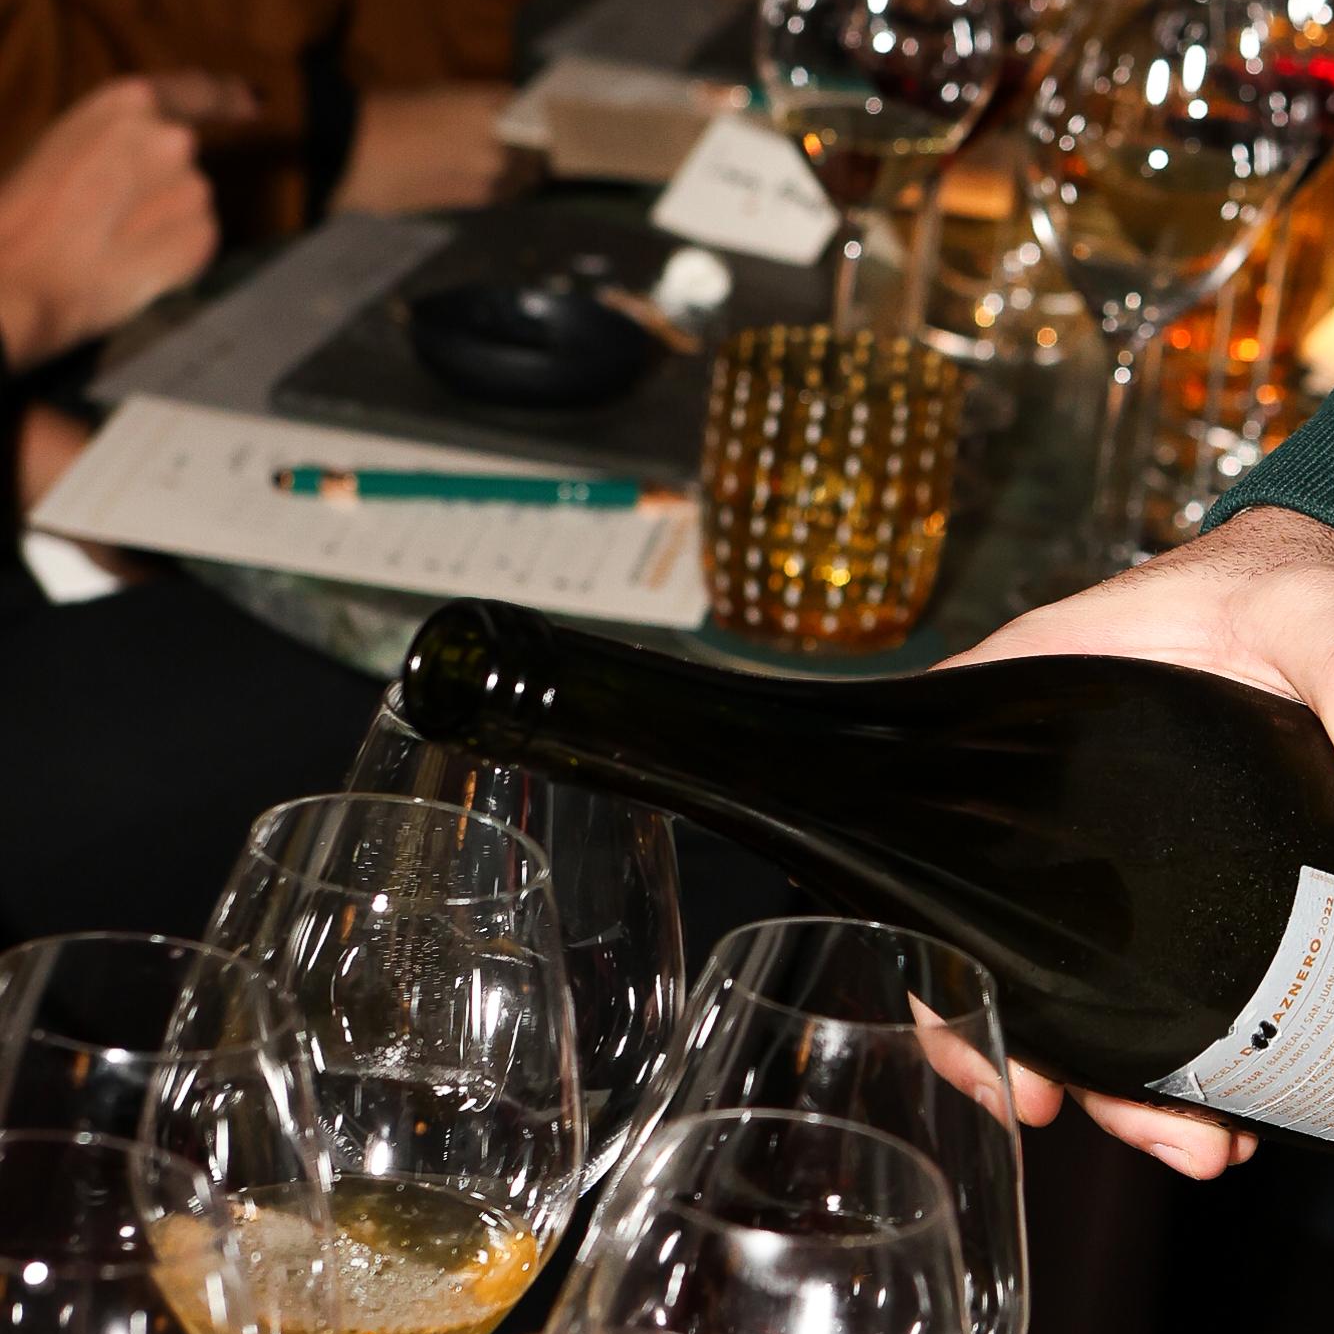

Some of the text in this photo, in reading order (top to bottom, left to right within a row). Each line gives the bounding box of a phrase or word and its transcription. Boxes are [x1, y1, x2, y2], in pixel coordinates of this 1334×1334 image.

[1196, 1058, 1243, 1089] ARCELA
[1240, 938, 1321, 1056] DAZNERO
[1317, 896, 1334, 935] 2022
[1241, 1070, 1263, 1084] SUR
[1265, 1031, 1303, 1066] BARREAL
[1302, 1003, 1321, 1023] SAN
[1274, 1041, 1310, 1074] HILARIO
